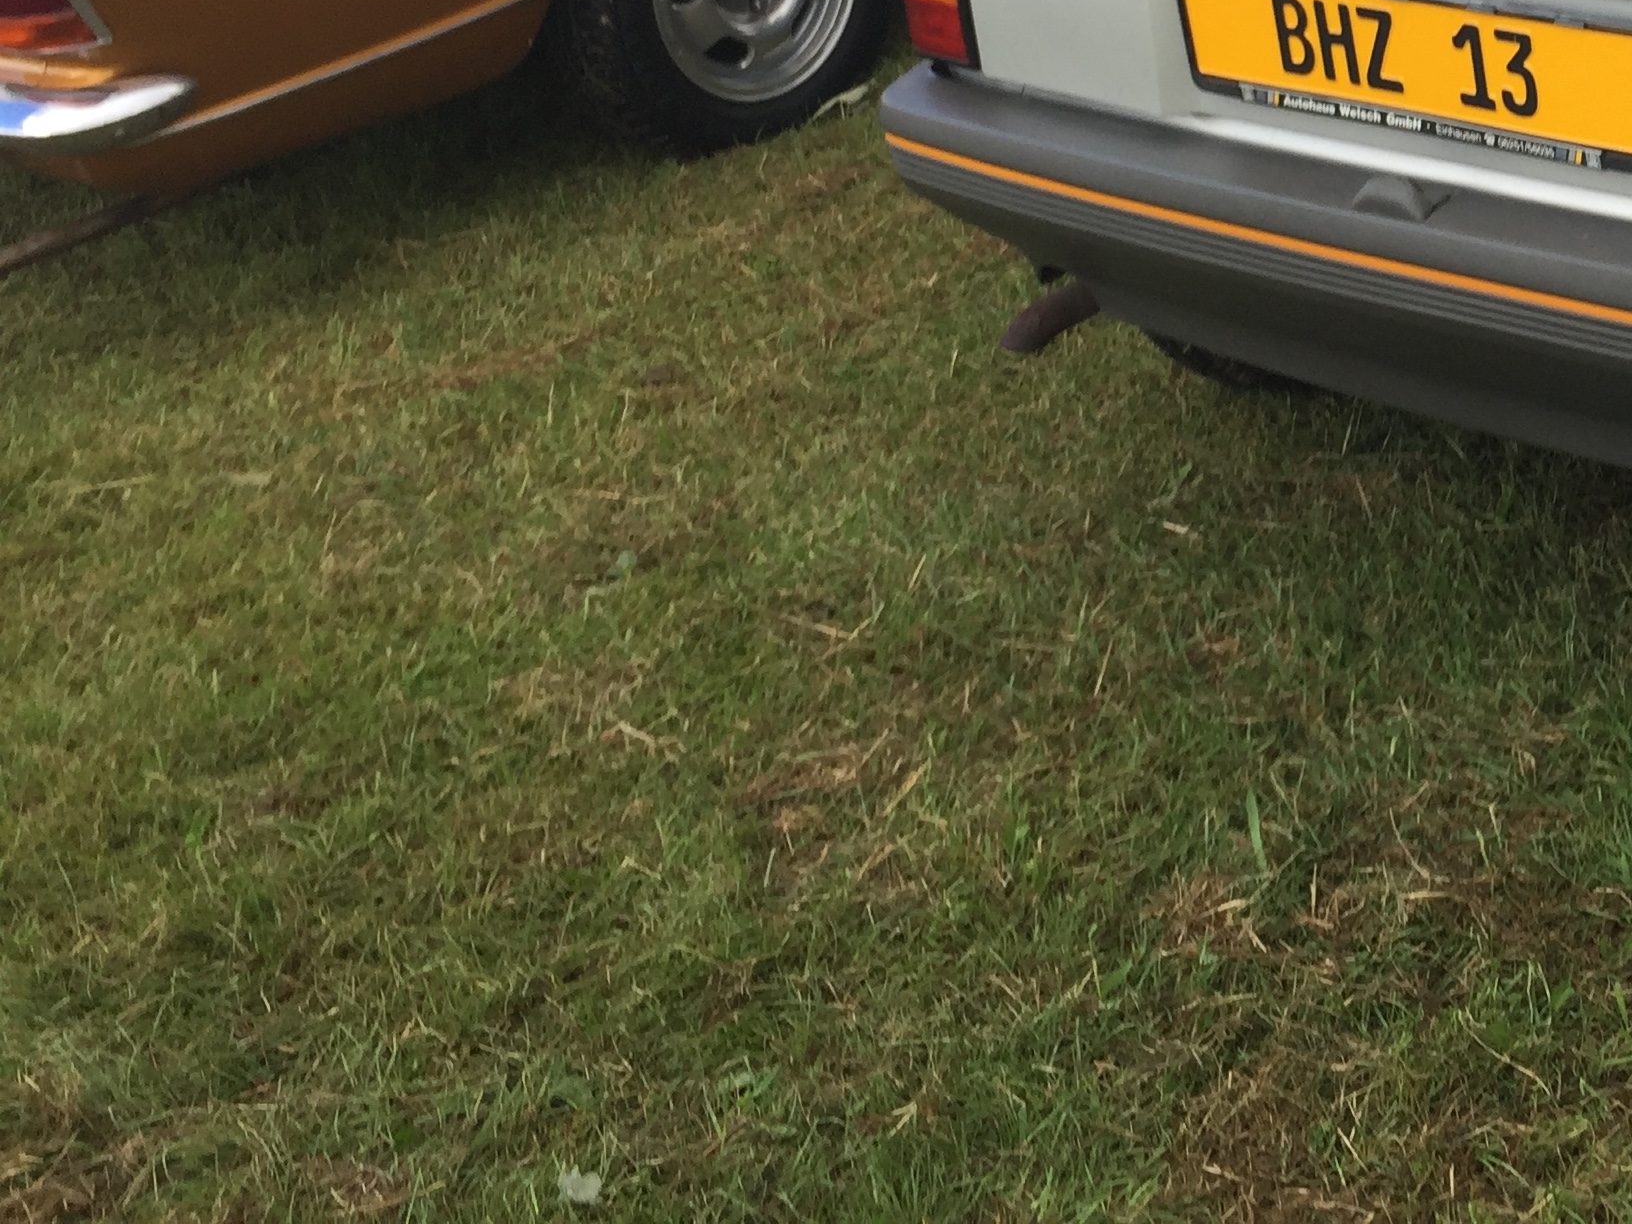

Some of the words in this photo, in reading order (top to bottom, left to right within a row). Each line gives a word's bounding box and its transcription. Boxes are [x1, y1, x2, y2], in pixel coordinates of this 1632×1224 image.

[1451, 24, 1539, 117] 13
[1283, 93, 1336, 116] Autohaus
[1386, 112, 1423, 132] GmbH
